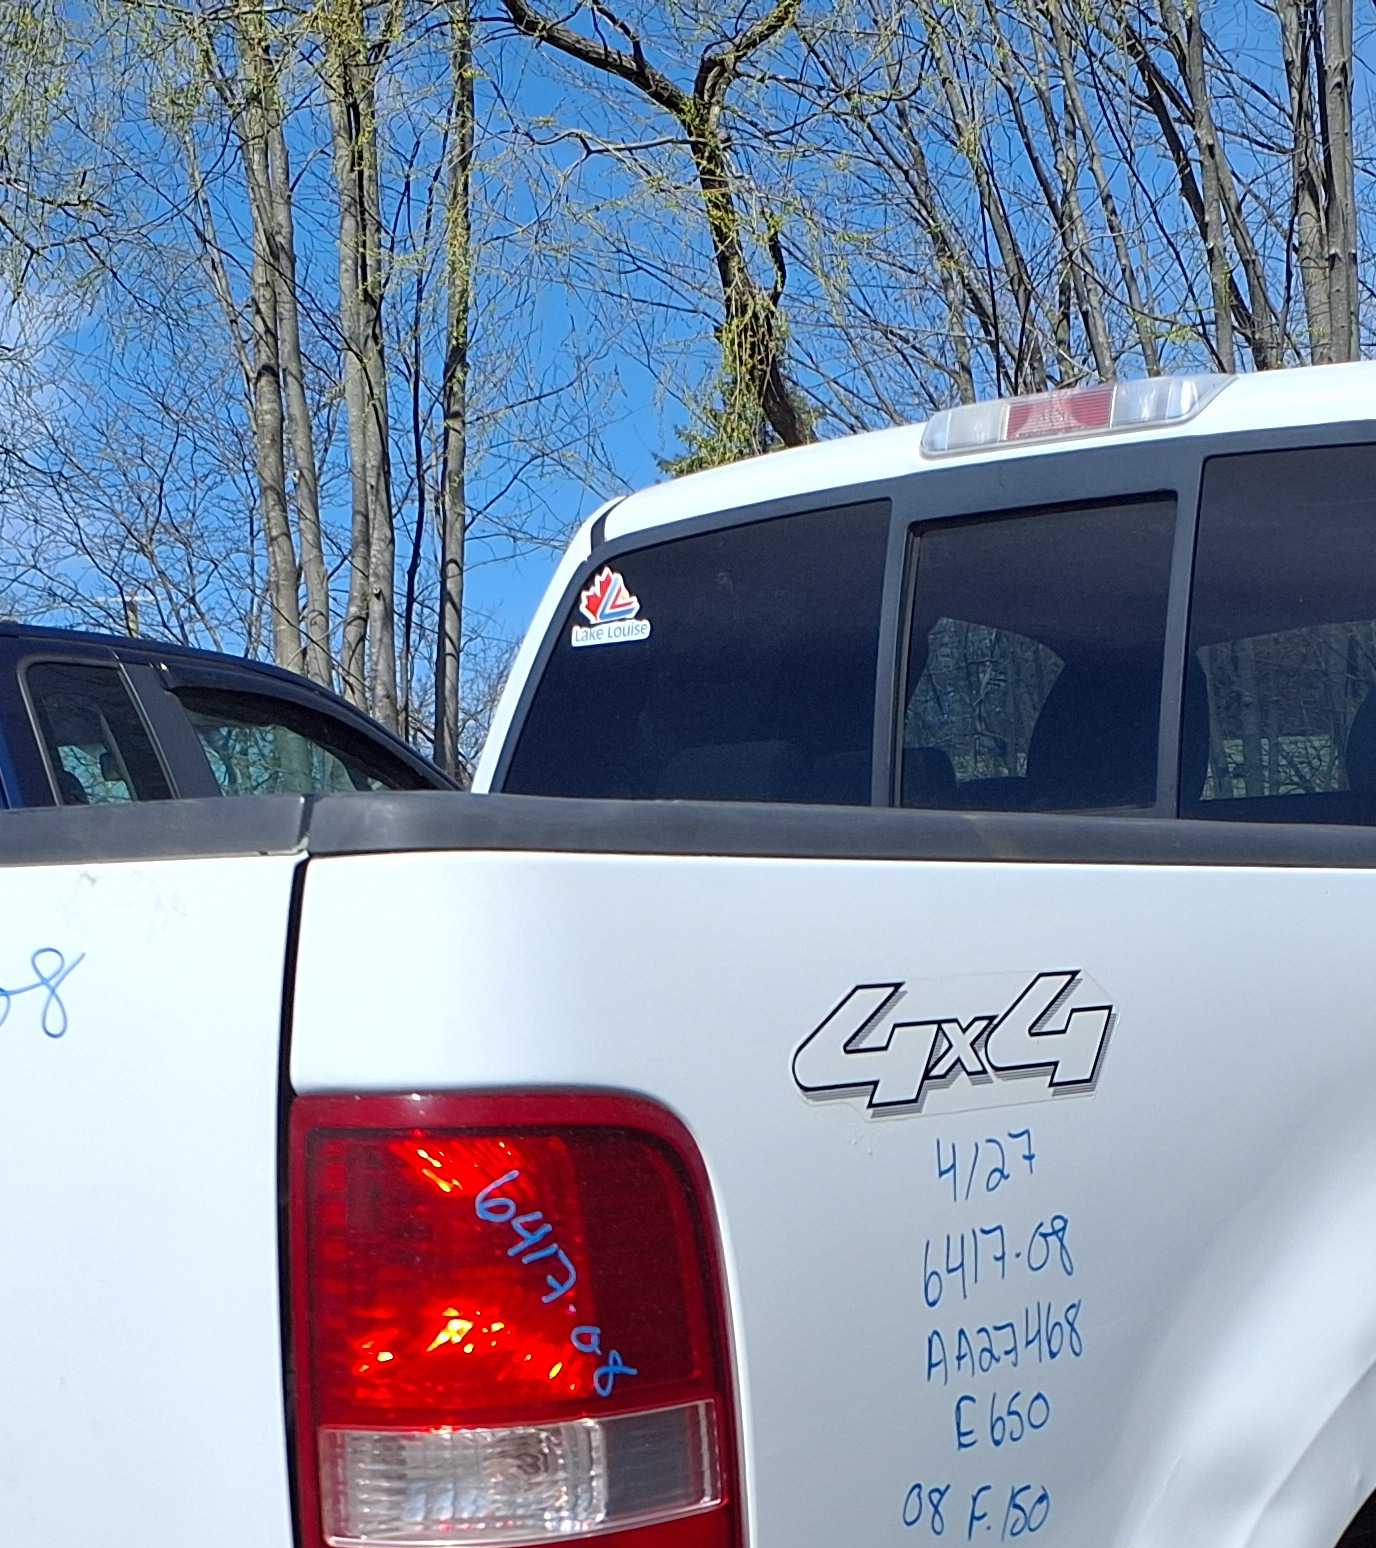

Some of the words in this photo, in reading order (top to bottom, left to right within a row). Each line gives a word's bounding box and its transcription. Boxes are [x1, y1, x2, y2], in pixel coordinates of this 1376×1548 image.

[791, 968, 1116, 1118] 4x4
[935, 1128, 1036, 1202] 4/27
[923, 1214, 1075, 1308] 6417.08
[926, 1298, 1083, 1386] AA27468
